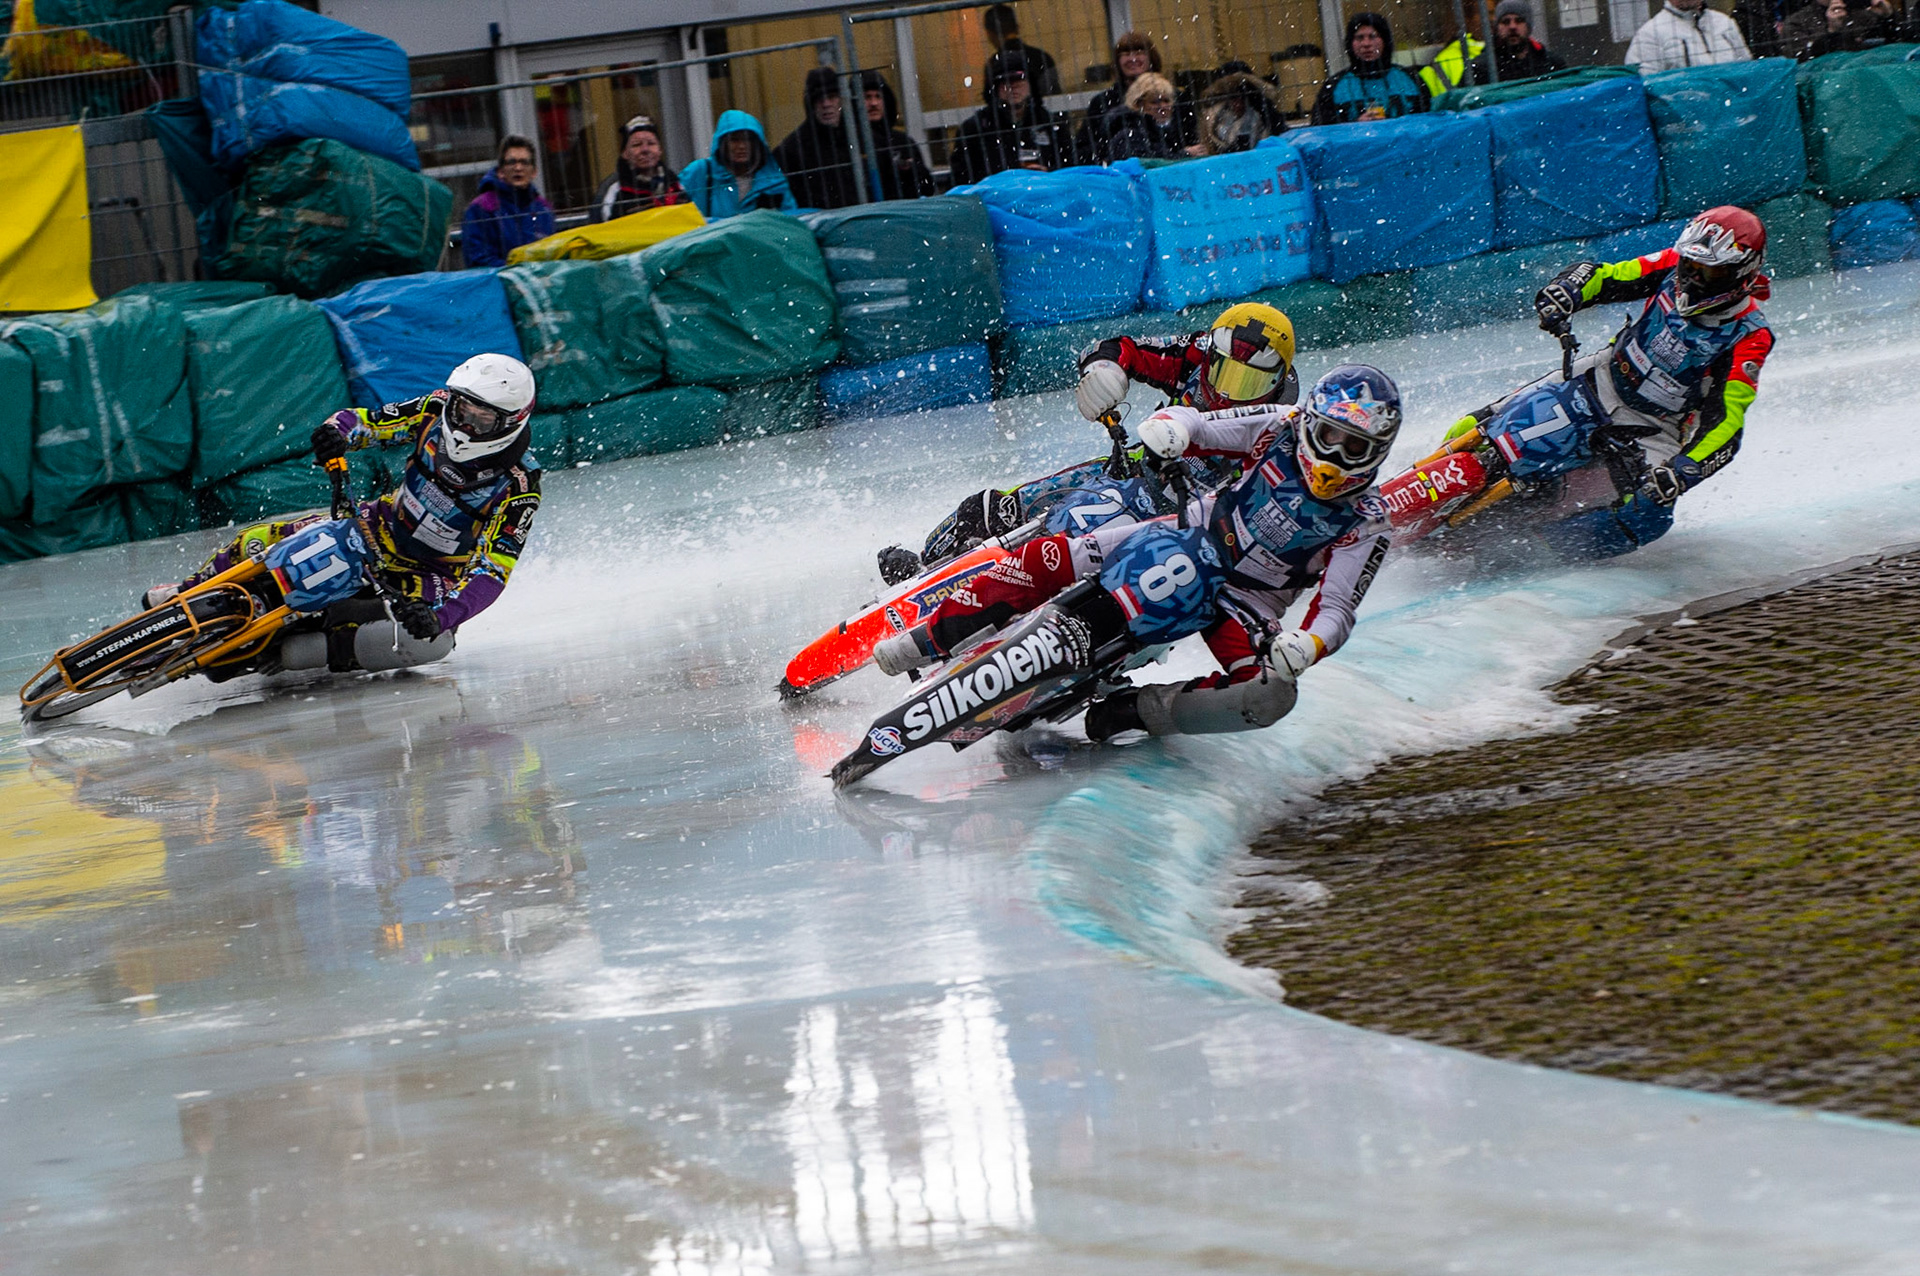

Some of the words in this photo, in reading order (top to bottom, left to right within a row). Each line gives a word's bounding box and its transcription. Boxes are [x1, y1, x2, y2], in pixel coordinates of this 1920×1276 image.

[1518, 403, 1571, 441] 7
[1263, 498, 1301, 538] ICE
[1289, 496, 1303, 510] 8
[290, 532, 351, 590] 11
[1138, 552, 1197, 603] 8
[903, 626, 1064, 741] silkolene
[869, 728, 904, 753] FUCHS
